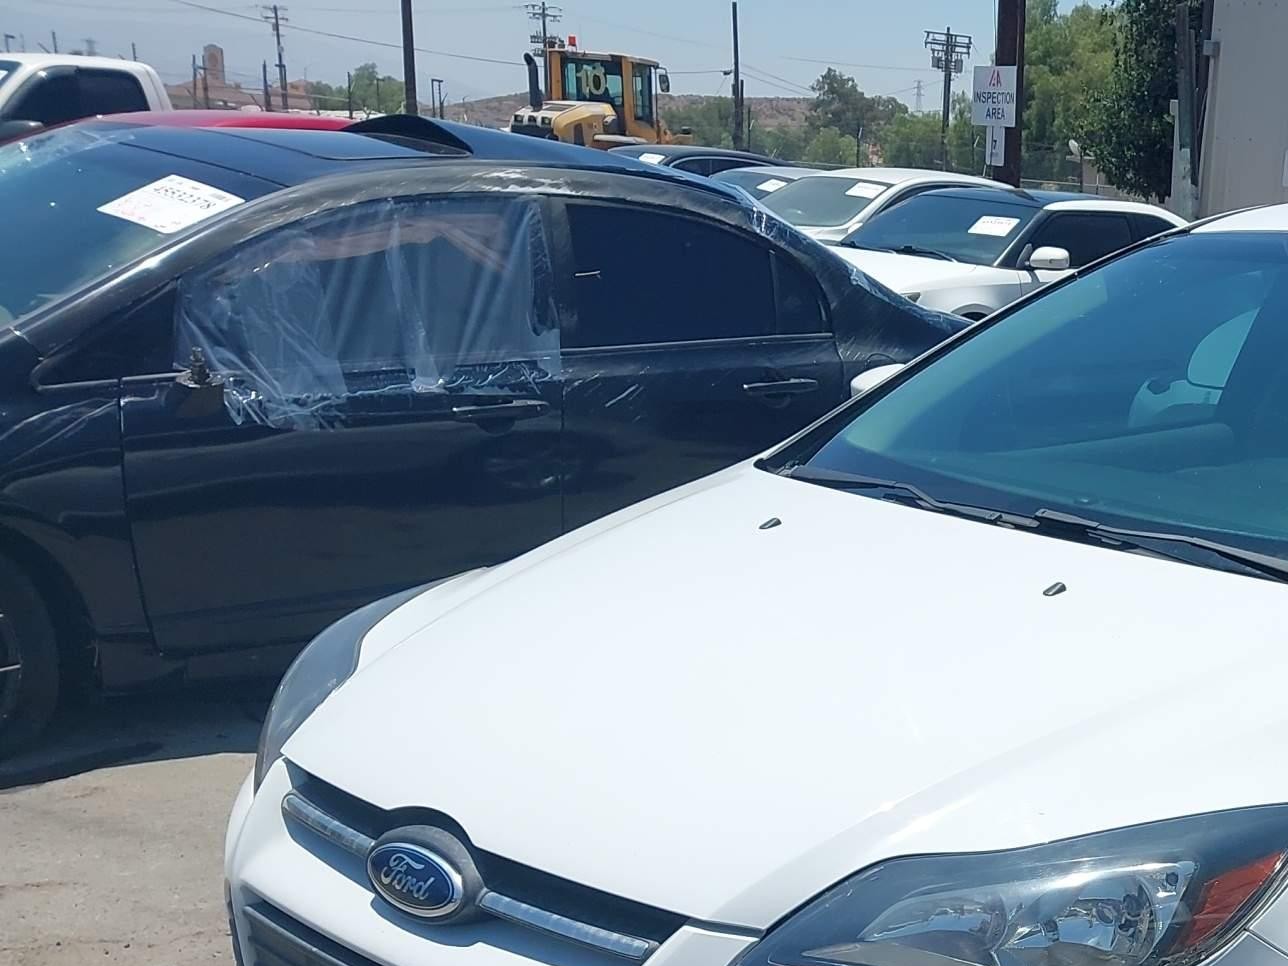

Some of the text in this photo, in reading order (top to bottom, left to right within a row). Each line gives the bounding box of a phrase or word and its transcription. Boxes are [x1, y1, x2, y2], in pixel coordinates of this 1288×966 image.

[973, 91, 1015, 105] INSPECTION
[985, 106, 1006, 121] AREA
[380, 852, 436, 901] Ford
